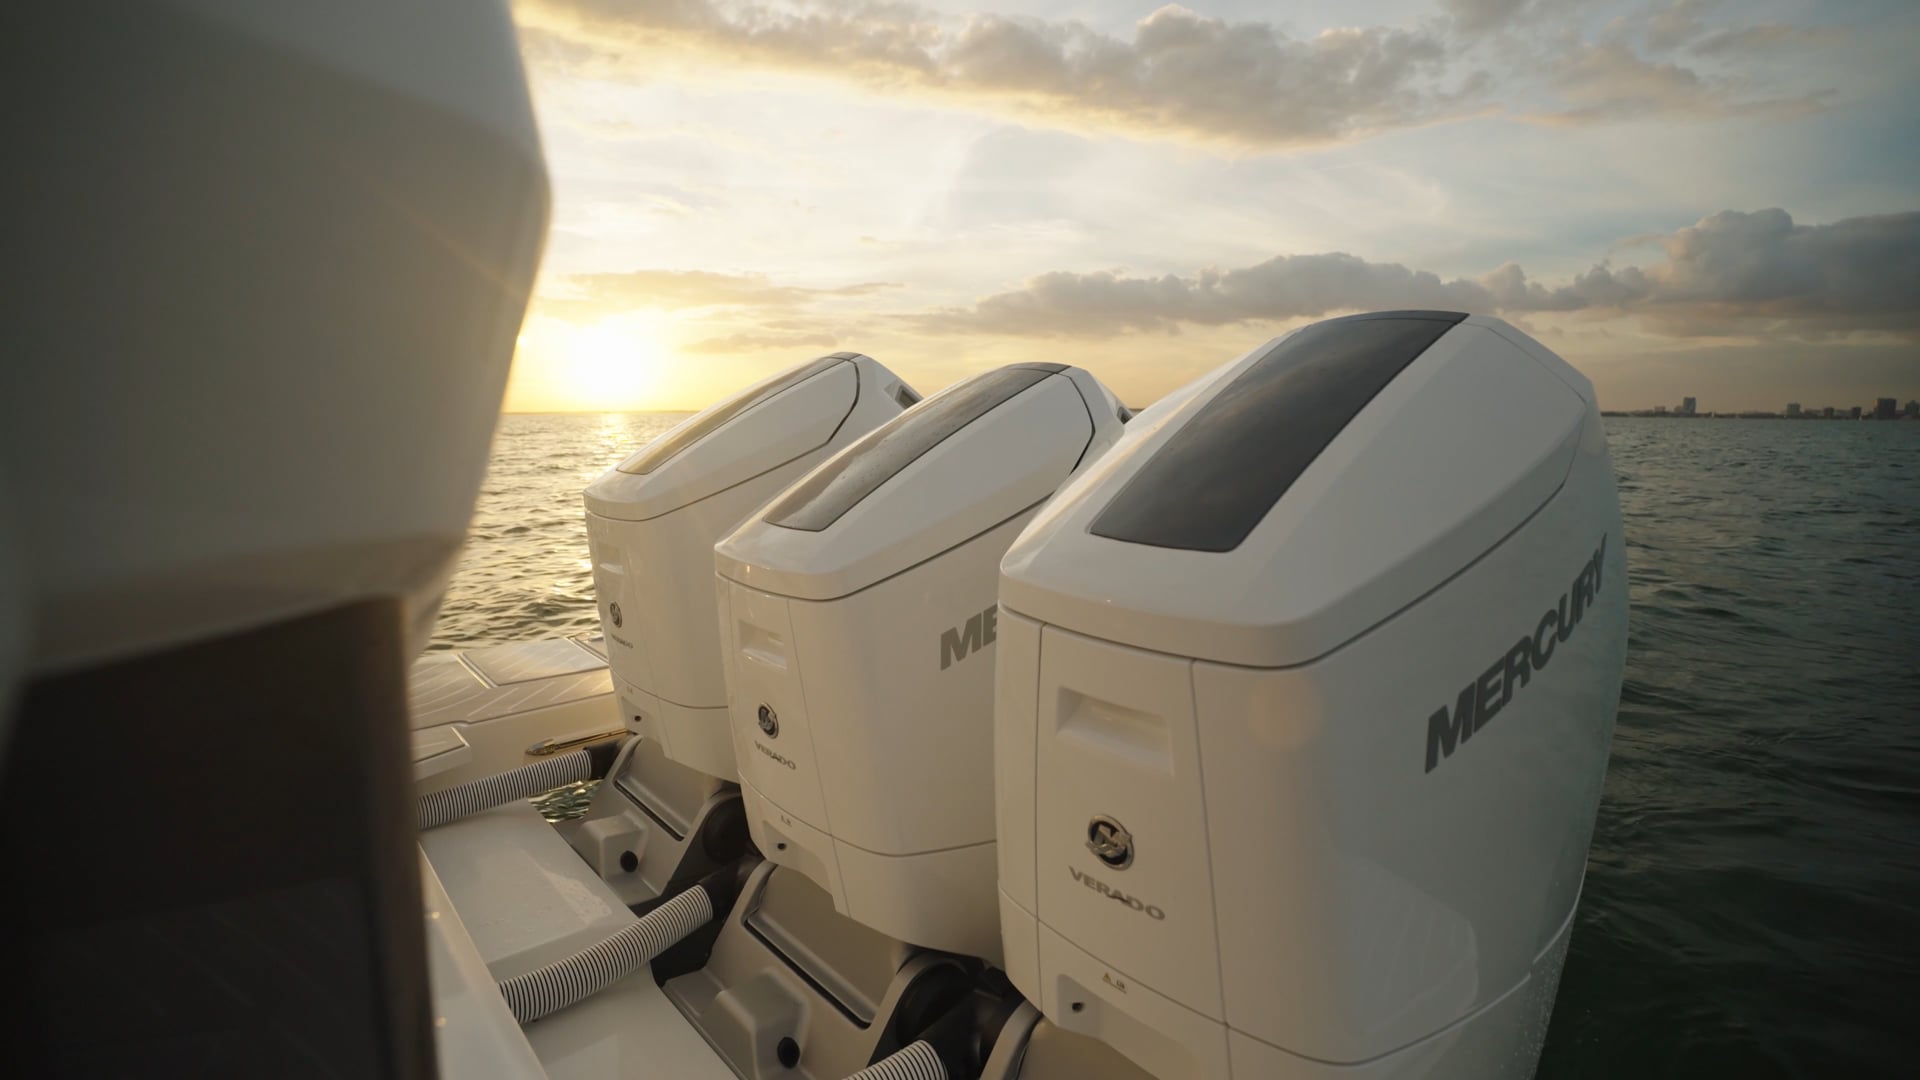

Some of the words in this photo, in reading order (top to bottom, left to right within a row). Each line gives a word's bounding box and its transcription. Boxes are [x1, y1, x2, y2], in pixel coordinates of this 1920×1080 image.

[1425, 532, 1607, 774] MERCURY
[754, 740, 796, 770] VERADO
[1068, 865, 1165, 921] VERADO
